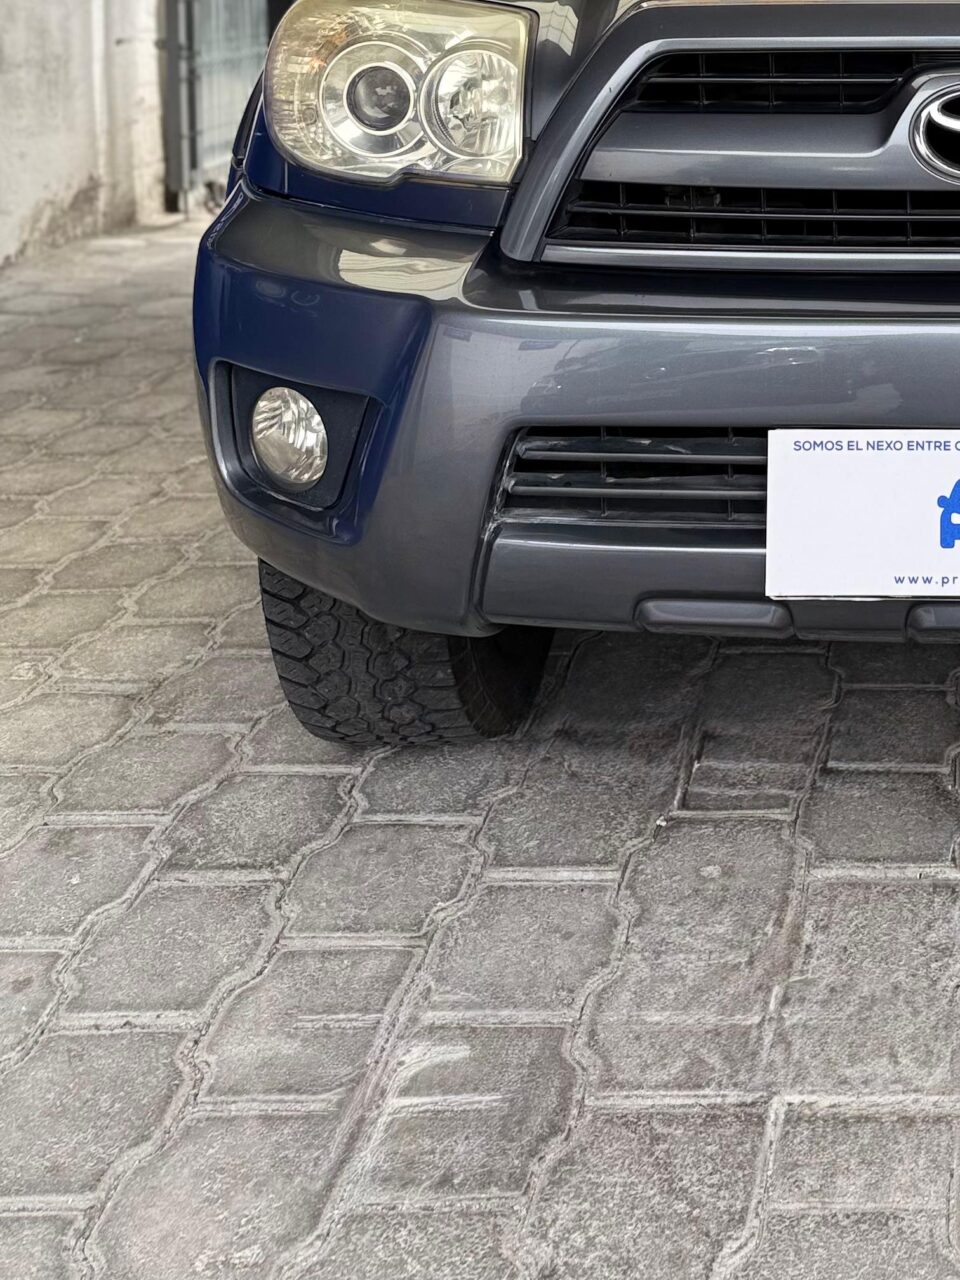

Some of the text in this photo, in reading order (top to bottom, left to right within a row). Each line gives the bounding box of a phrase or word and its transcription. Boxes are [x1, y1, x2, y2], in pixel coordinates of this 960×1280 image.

[793, 440, 843, 452] SOMOS
[847, 440, 863, 451] EL
[866, 440, 904, 451] NEXO
[907, 440, 951, 451] ENTRE
